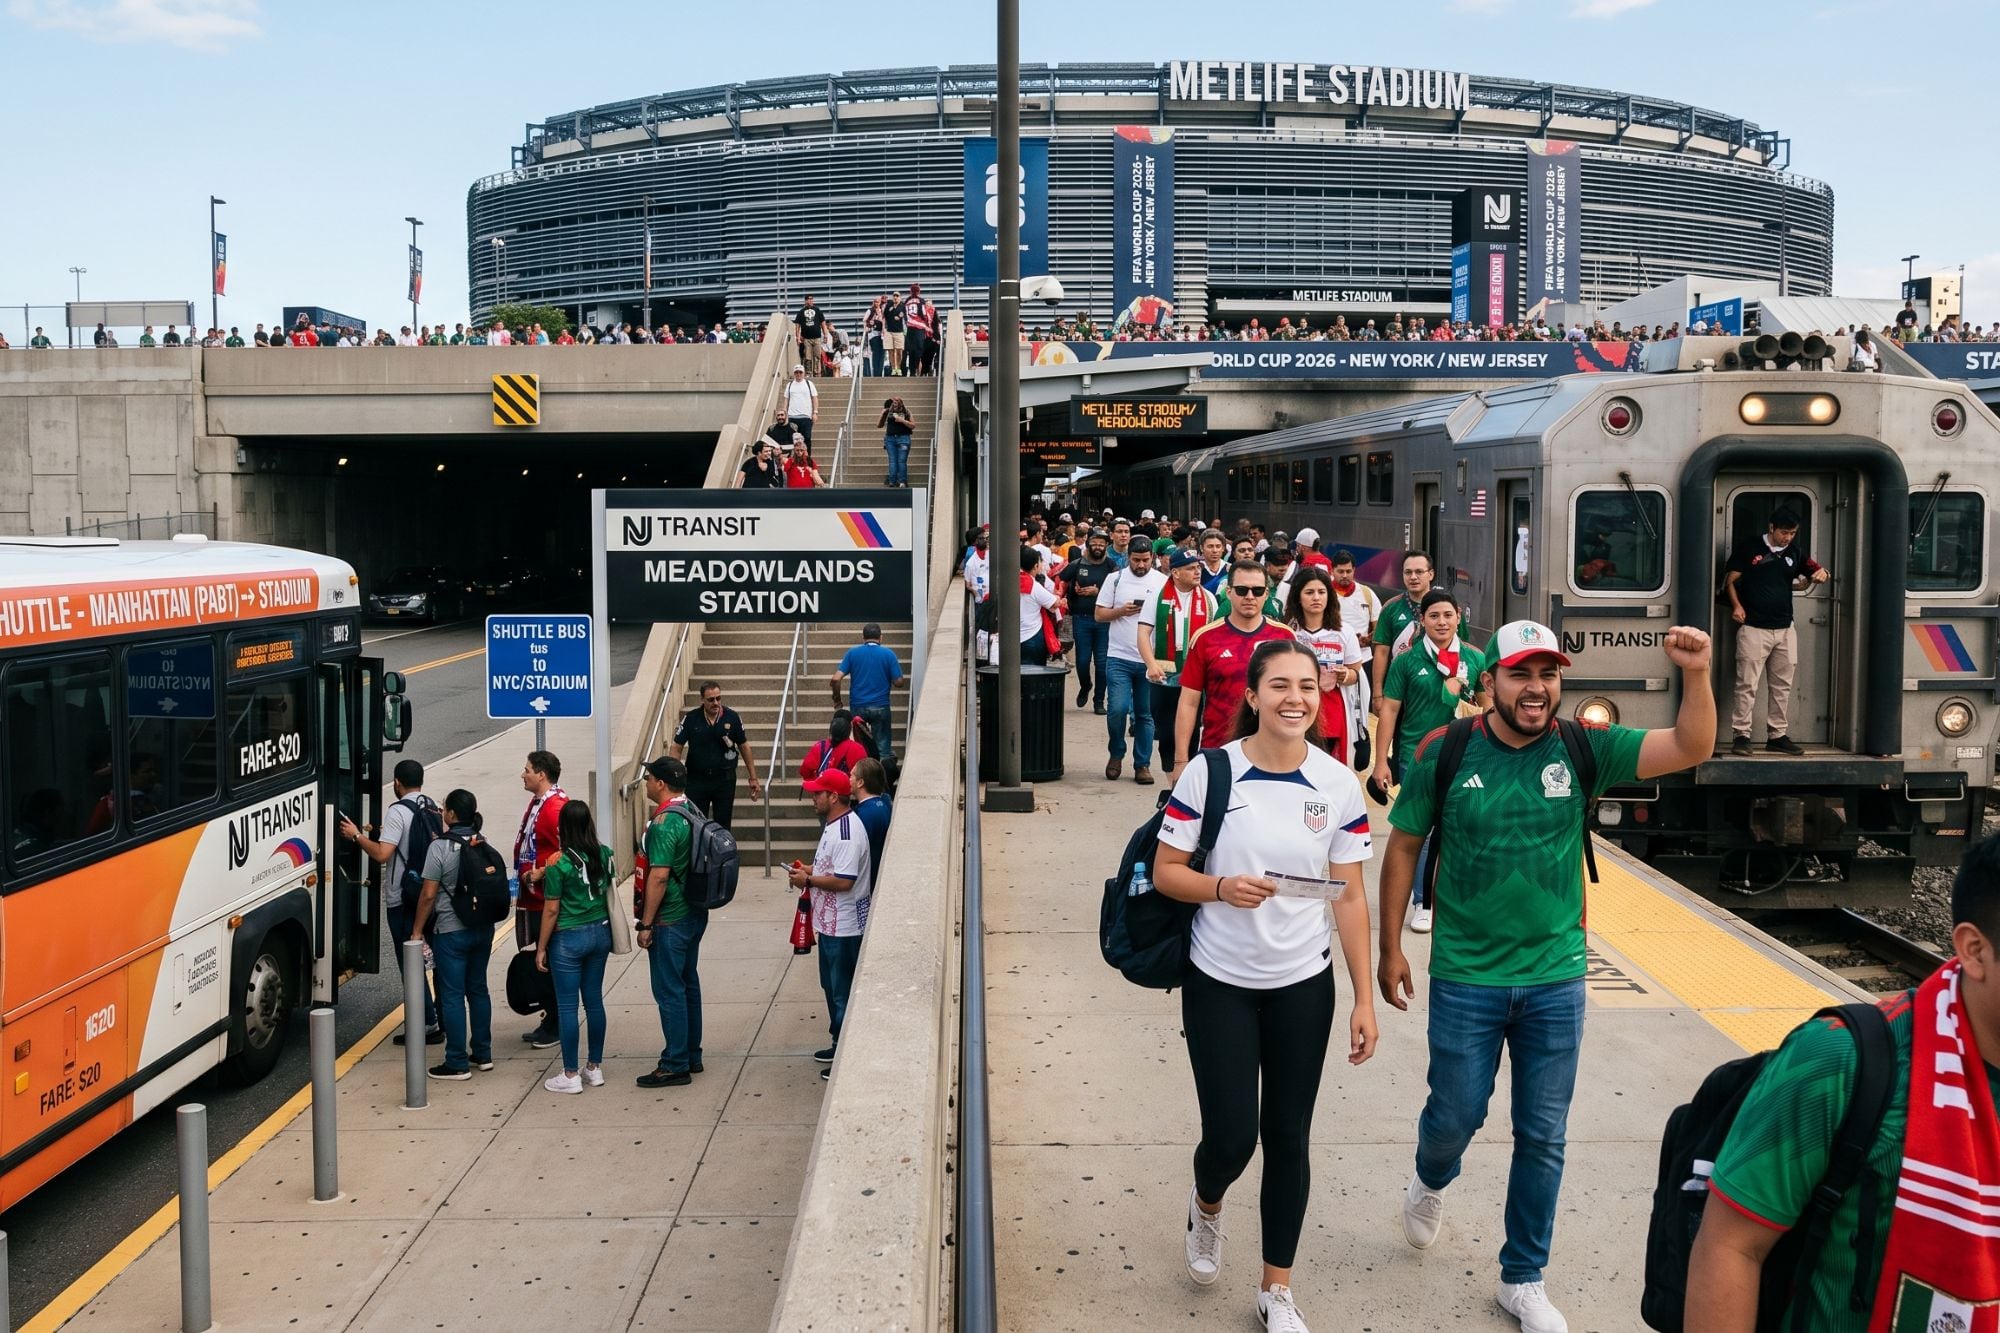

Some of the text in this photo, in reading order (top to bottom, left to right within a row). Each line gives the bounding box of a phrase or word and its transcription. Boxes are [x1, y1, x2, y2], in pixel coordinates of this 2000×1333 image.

[1170, 60, 1470, 110] METLIFE STADIUM
[1132, 161, 1143, 188] 2026
[1145, 155, 1155, 194] JERSEY
[1545, 171, 1555, 197] 2026
[1556, 165, 1566, 204] JERSEY
[1132, 189, 1143, 212] CUP
[1145, 196, 1155, 221] NEW
[1545, 199, 1555, 221] CUP
[1556, 205, 1566, 229] NEW
[1132, 213, 1143, 257] WORLD
[1145, 229, 1155, 258] YORK
[1544, 222, 1555, 265] WORLD
[1556, 236, 1566, 264] YORK
[1132, 257, 1143, 283] FIFA
[1544, 266, 1555, 291] FIFA
[1293, 290, 1393, 303] METLIFE STADIUM
[1211, 353, 1256, 367] ORLD
[1258, 353, 1292, 368] CUP
[1295, 353, 1336, 368] 2026
[1350, 353, 1389, 368] NEW
[1390, 353, 1435, 368] YORK
[1436, 352, 1446, 368] /
[1448, 353, 1487, 368] NEW
[1488, 353, 1548, 368] JERSEY
[1081, 403, 1133, 416] METLIFE
[657, 516, 760, 536] TRANSIT
[644, 559, 875, 583] MEADOWLANDS
[89, 586, 191, 627] MANHATTAN
[194, 583, 239, 624] (PABT)
[258, 578, 312, 609] STADIUM
[699, 590, 819, 614] STATION
[492, 623, 586, 639] SHUTTLE BUS
[1589, 631, 1670, 647] TRANSIT
[532, 657, 547, 672] to
[493, 674, 588, 692] NYC/STADIUM
[240, 732, 301, 776] FARE: $20
[251, 790, 313, 843] TRANSIT
[40, 1078, 76, 1116] FARE:
